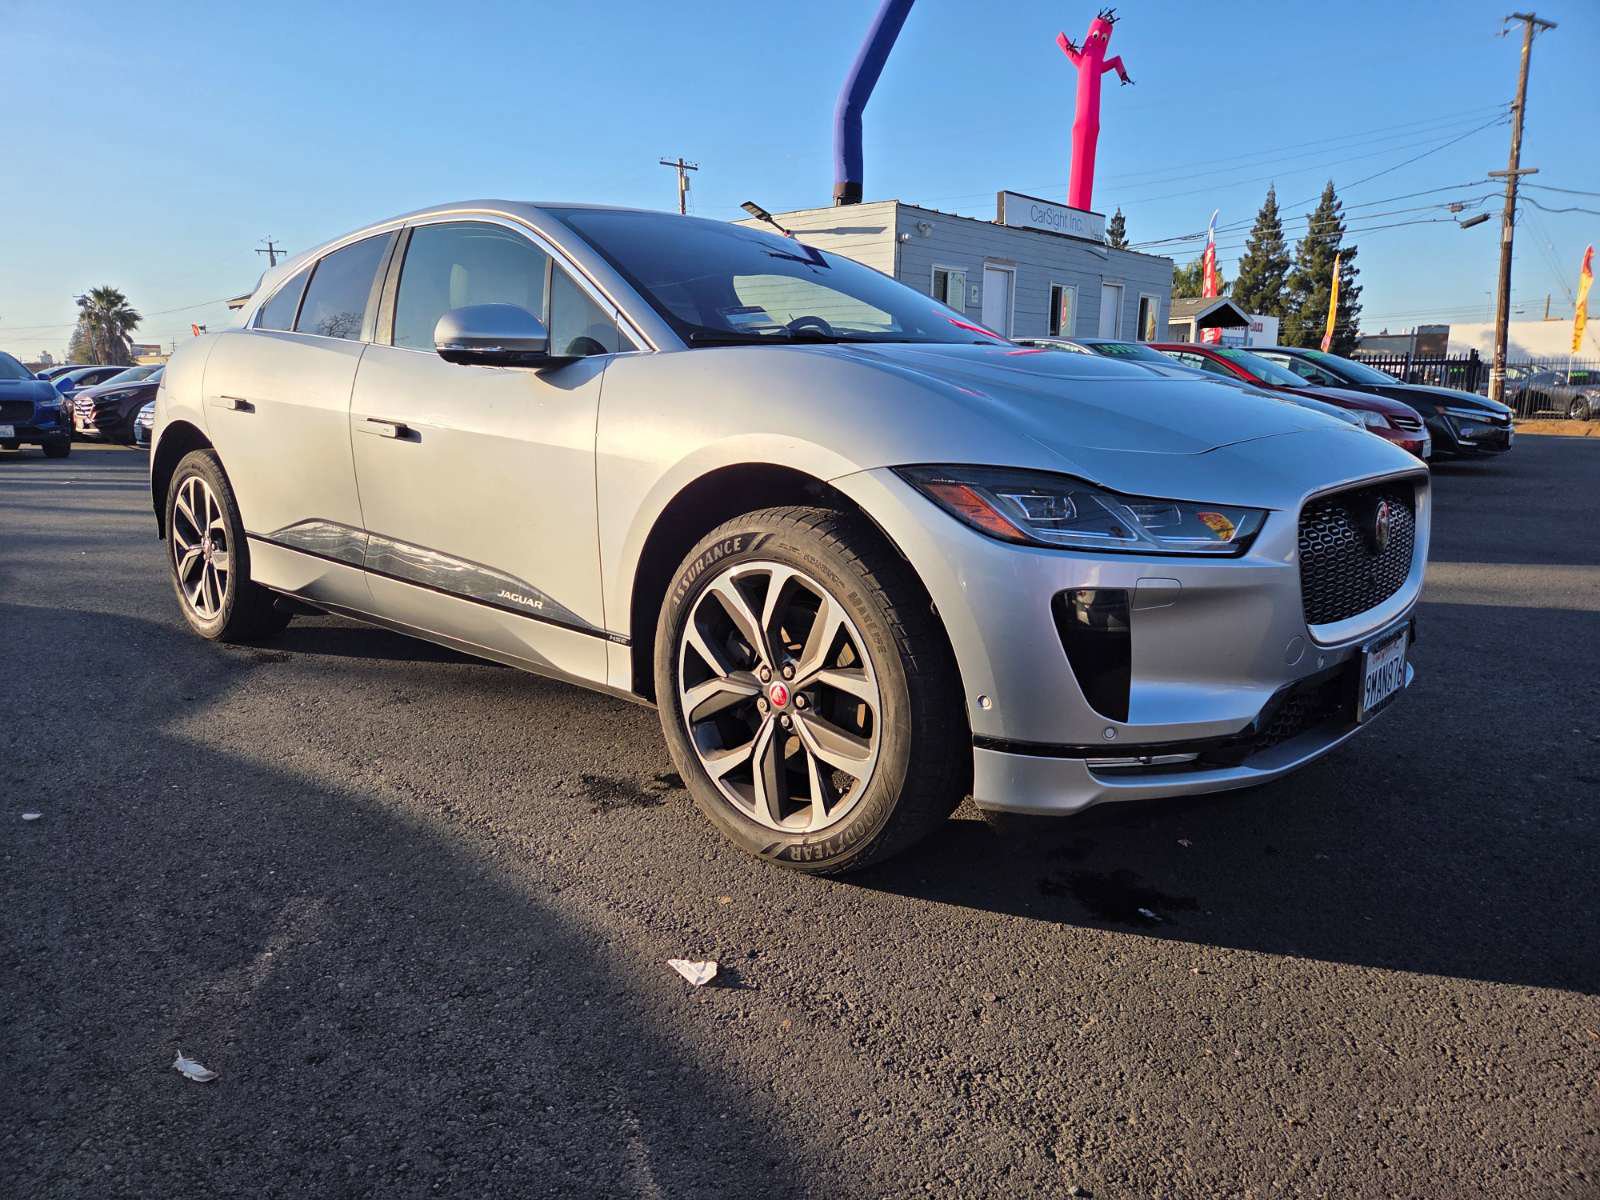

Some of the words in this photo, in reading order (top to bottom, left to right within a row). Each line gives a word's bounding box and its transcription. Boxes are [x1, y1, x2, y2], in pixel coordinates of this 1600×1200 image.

[1031, 205, 1067, 231] CarSight
[497, 590, 543, 609] JAGUAR
[673, 537, 742, 609] ASSURANCE
[1364, 655, 1404, 710] 9MAN876
[790, 800, 883, 861] GOODYEAR
